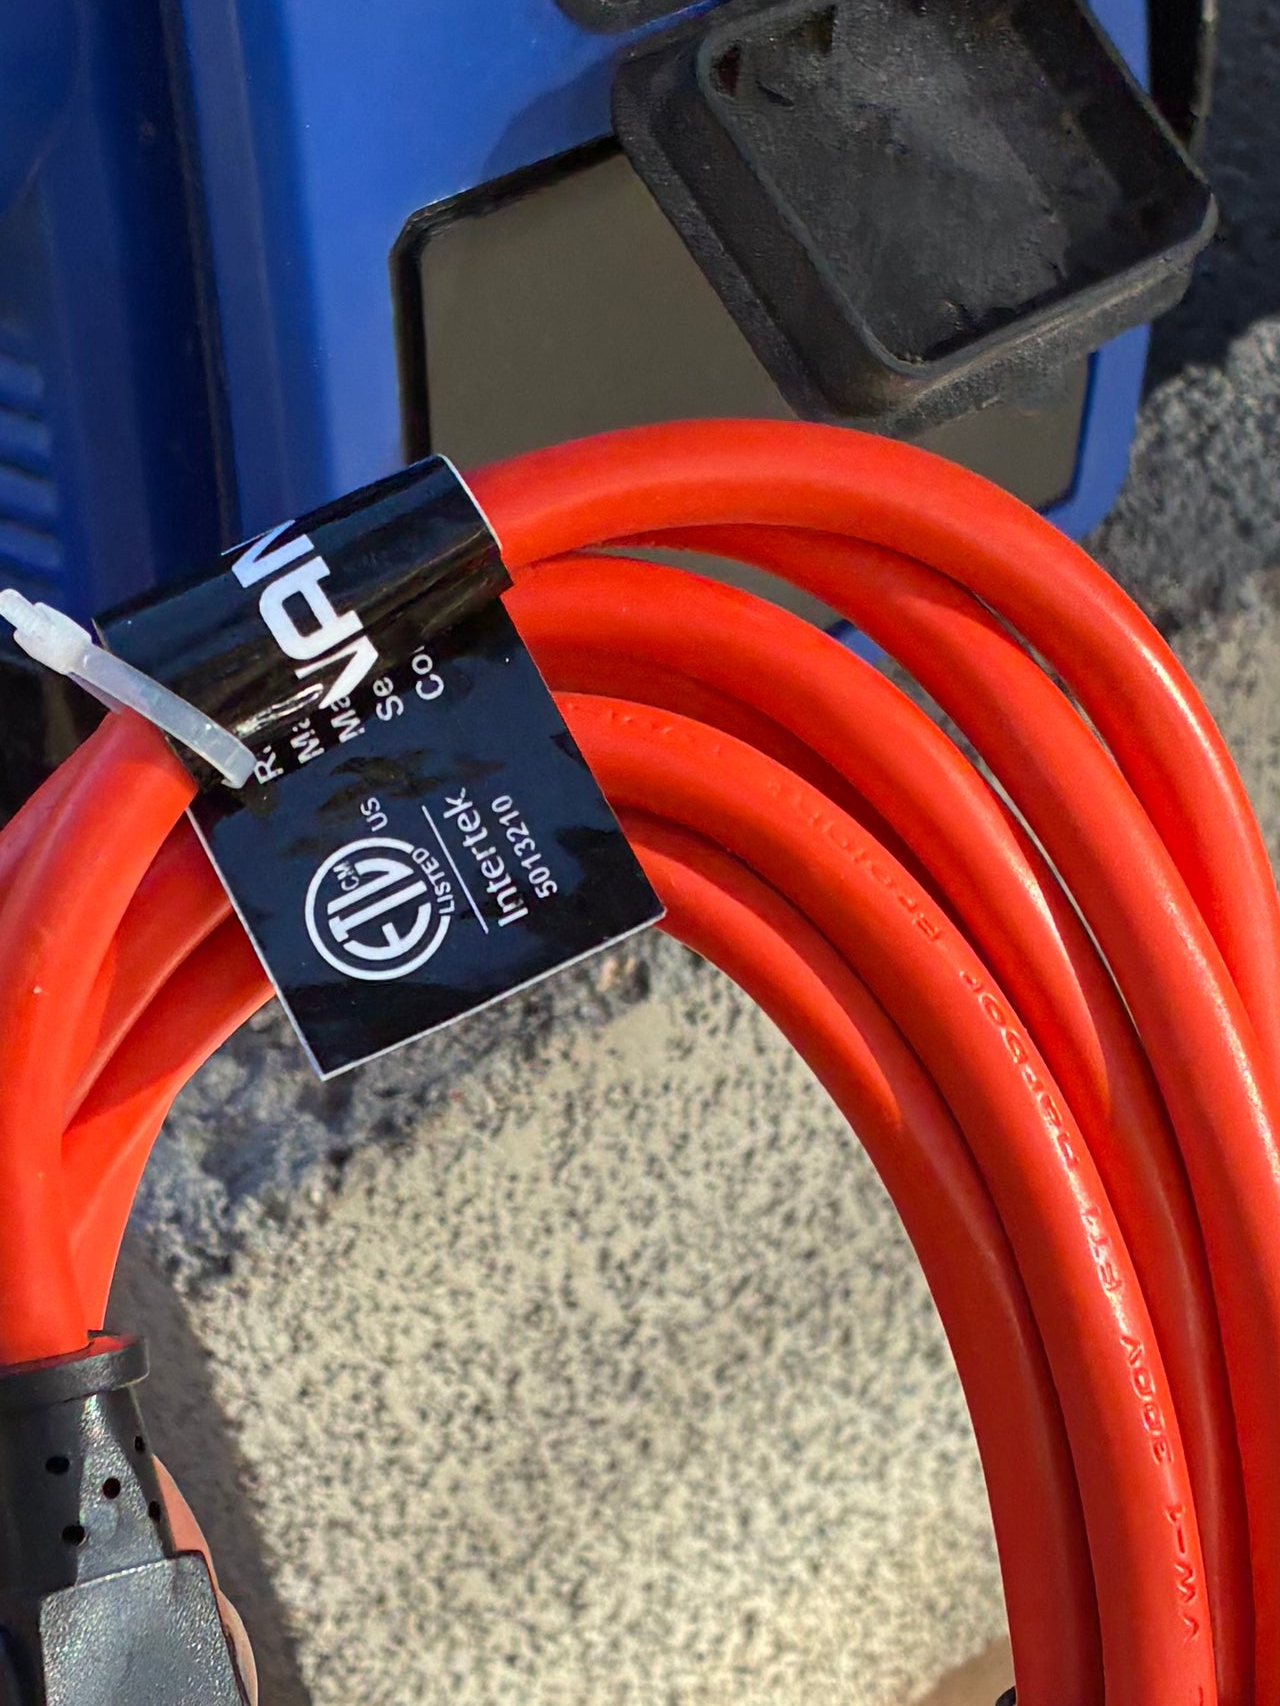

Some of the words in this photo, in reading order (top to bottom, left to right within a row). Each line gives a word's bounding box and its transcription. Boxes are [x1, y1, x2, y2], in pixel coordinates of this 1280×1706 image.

[411, 645, 444, 701] Co
[253, 746, 285, 785] R
[360, 796, 388, 833] US
[442, 786, 529, 928] Intertek
[491, 794, 558, 899] 5013210
[327, 857, 432, 961] ETL
[411, 846, 455, 916] LISTED
[956, 961, 1082, 1172] Harbor
